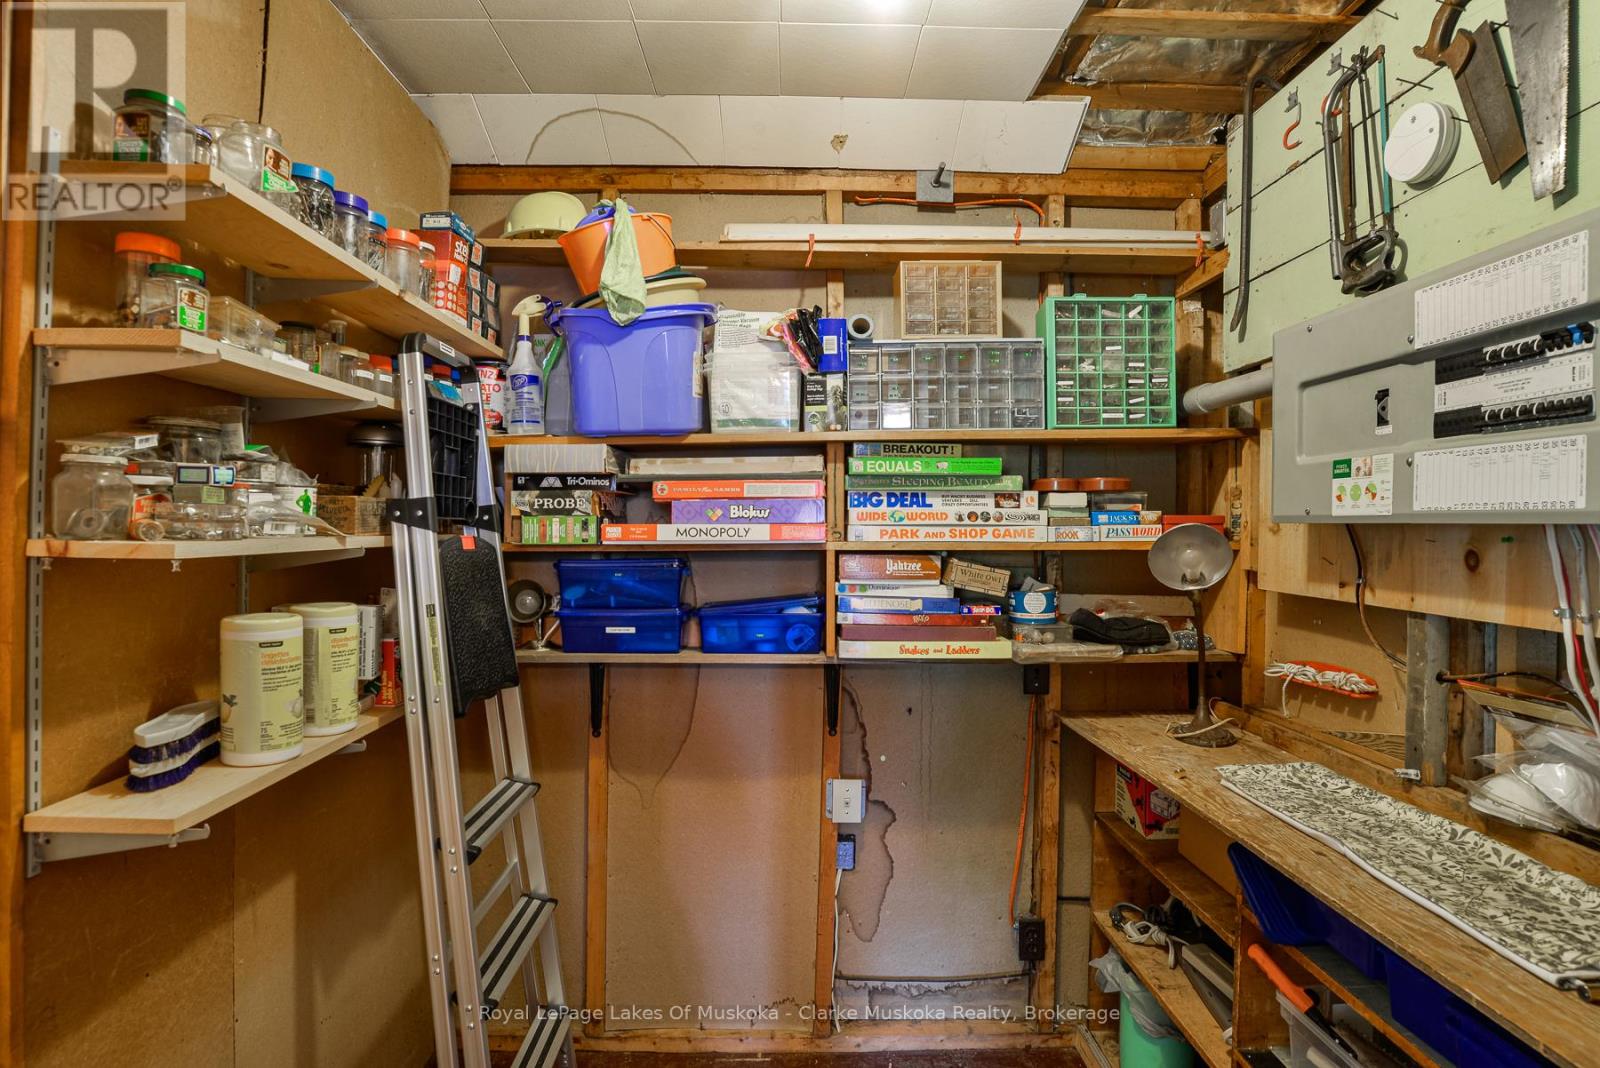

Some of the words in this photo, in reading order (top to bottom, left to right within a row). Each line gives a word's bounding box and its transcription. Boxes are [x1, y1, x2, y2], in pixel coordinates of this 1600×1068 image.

[867, 461, 922, 472] EQUALS
[566, 477, 609, 486] Tri-Ominos
[534, 498, 586, 509] PROBE
[849, 492, 883, 508] BIG
[886, 492, 933, 508] DEAL
[729, 504, 770, 520] Blokus
[856, 511, 887, 522] WIDE
[907, 511, 948, 522] WORLD
[676, 527, 750, 537] MONOPOLY
[879, 529, 919, 539] PARK
[949, 528, 988, 539] SHOP
[992, 529, 1035, 538] GAME
[1105, 528, 1162, 538] PASSWORD
[886, 558, 922, 575] Yahtzee
[960, 569, 984, 579] White
[899, 644, 929, 655] Snakes
[946, 645, 980, 654] Ladders
